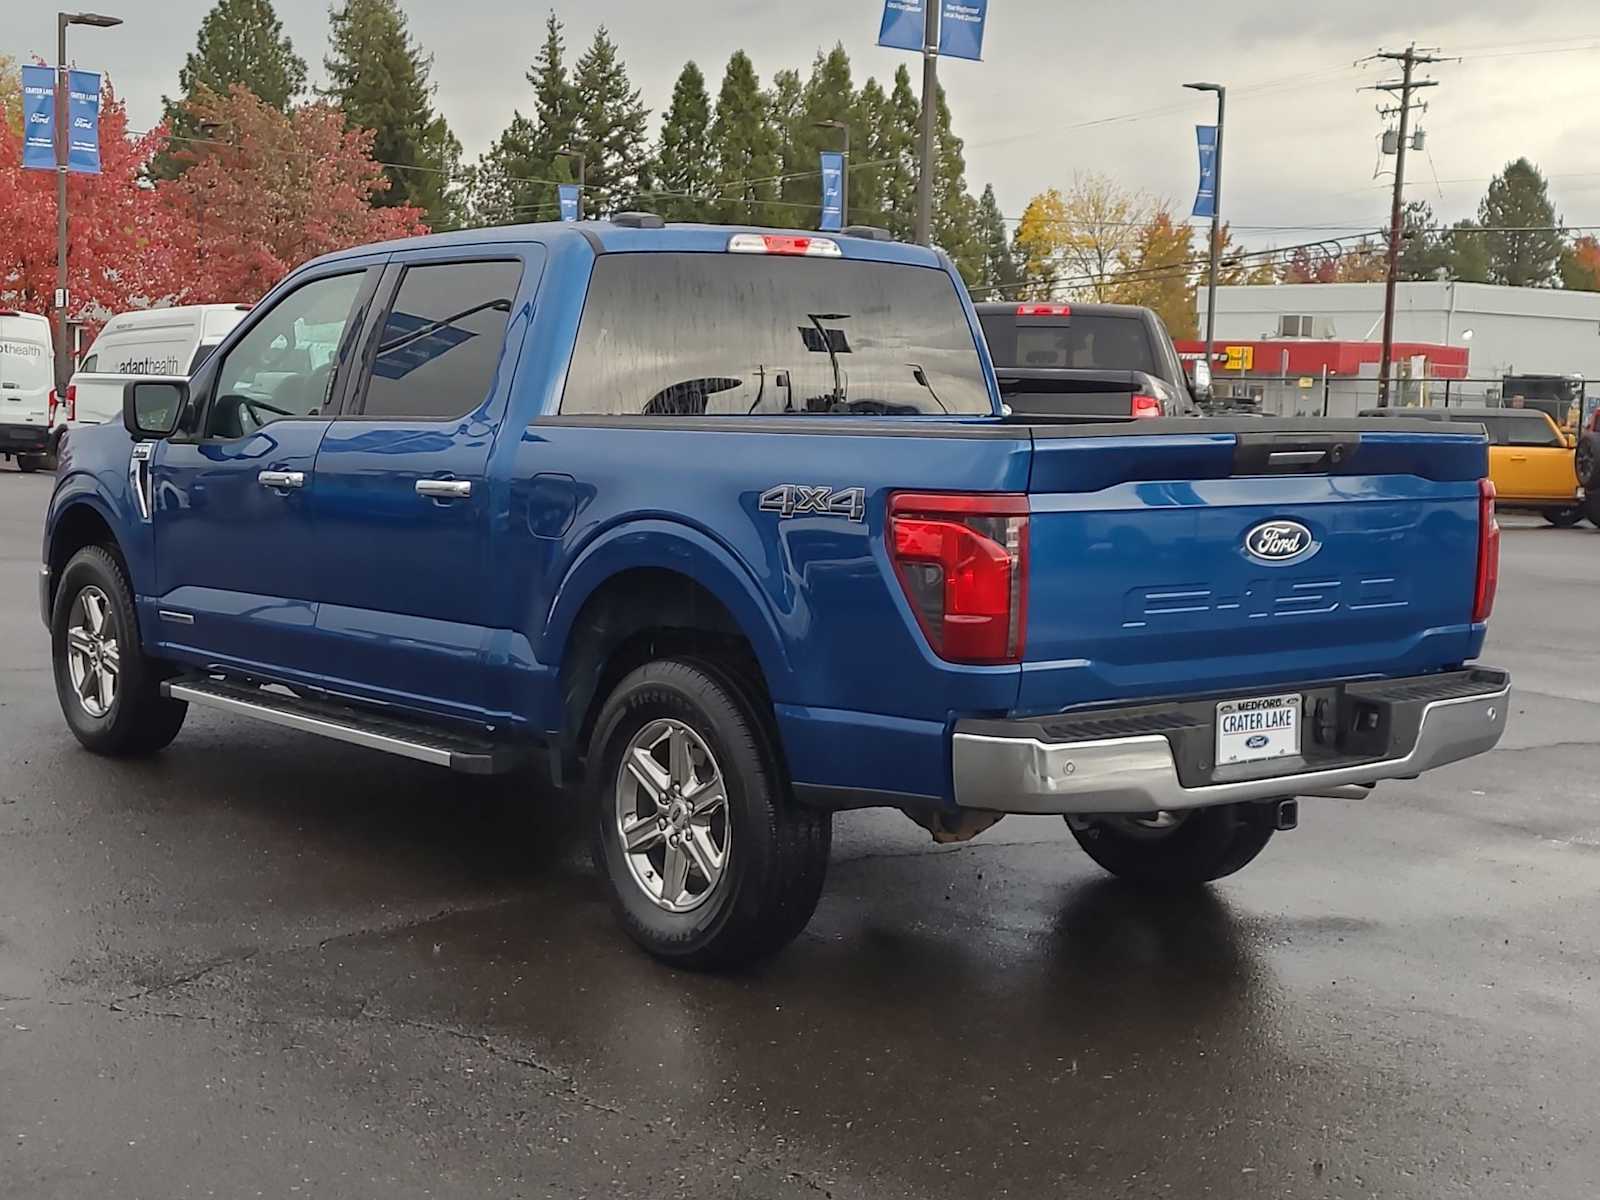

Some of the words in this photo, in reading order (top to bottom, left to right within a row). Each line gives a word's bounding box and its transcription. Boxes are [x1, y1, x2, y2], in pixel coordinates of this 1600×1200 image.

[31, 113, 50, 124] Ford
[1258, 527, 1301, 553] Ford
[1238, 698, 1282, 711] MEDFORD
[1223, 713, 1263, 733] CRATER
[1266, 709, 1292, 728] LAKE
